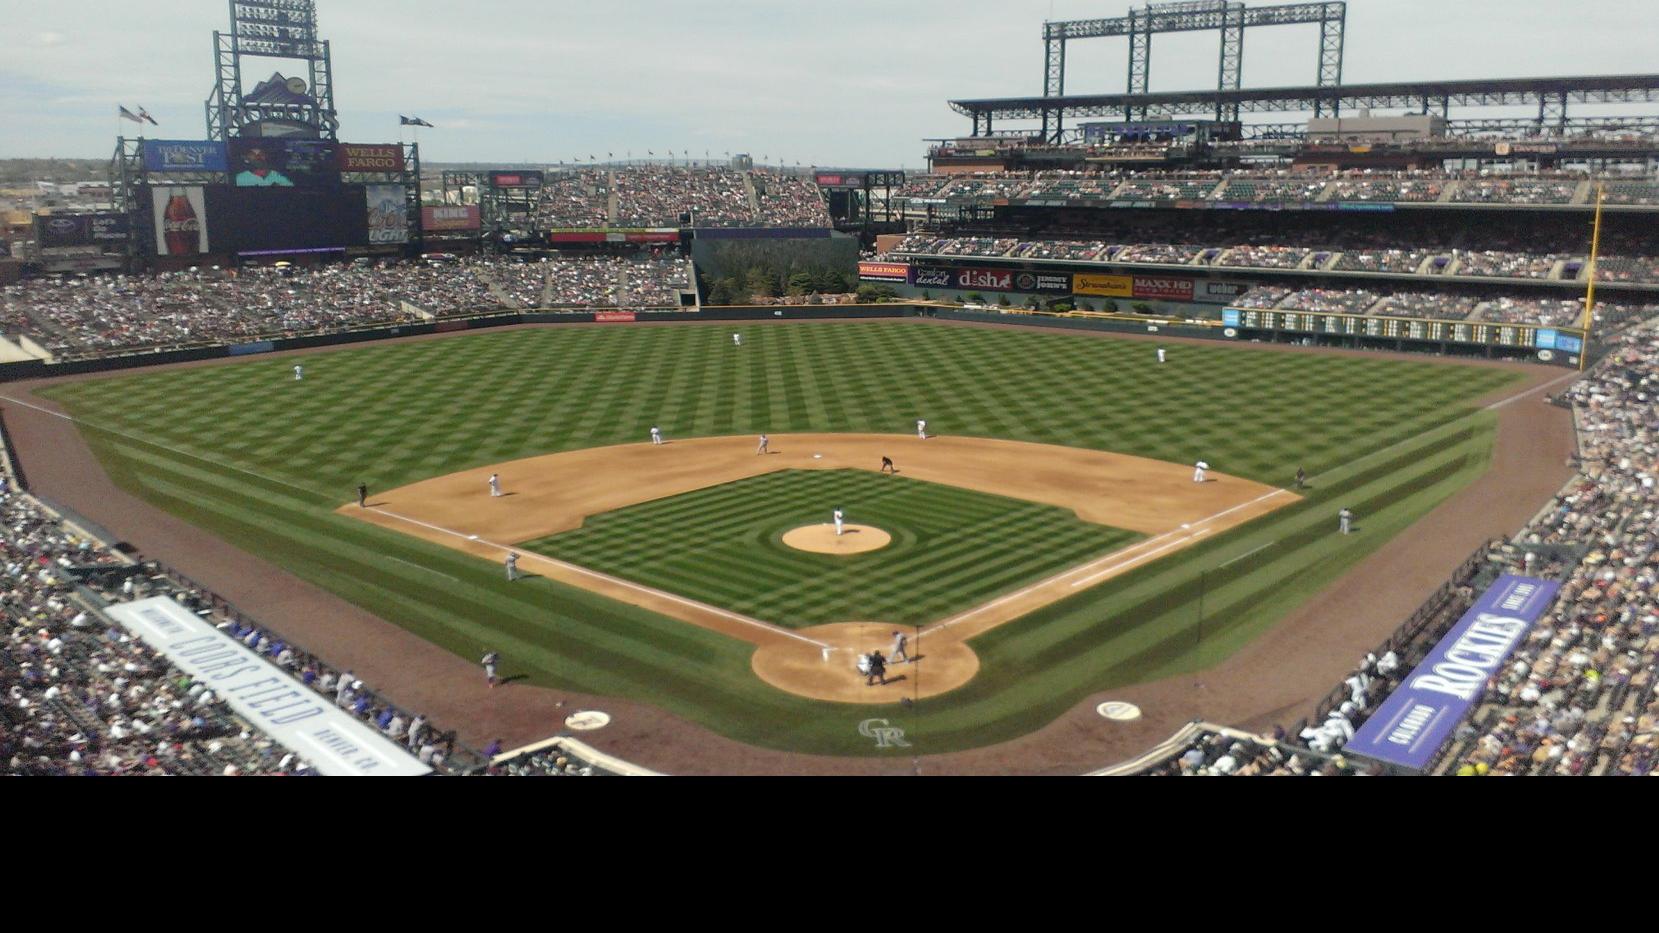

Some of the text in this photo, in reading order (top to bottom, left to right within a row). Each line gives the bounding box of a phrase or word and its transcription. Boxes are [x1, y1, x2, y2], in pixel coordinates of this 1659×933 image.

[345, 148, 396, 157] WELLS
[347, 158, 396, 168] FARGO
[369, 229, 408, 243] LIGHT
[860, 265, 883, 273] WELLS
[916, 275, 950, 285] dental
[959, 270, 998, 288] dish
[1036, 275, 1068, 283] JIMMY
[1134, 279, 1193, 289] MAXX HD
[1408, 611, 1529, 700] ROCKIES
[168, 635, 324, 725] COORS FIELD
